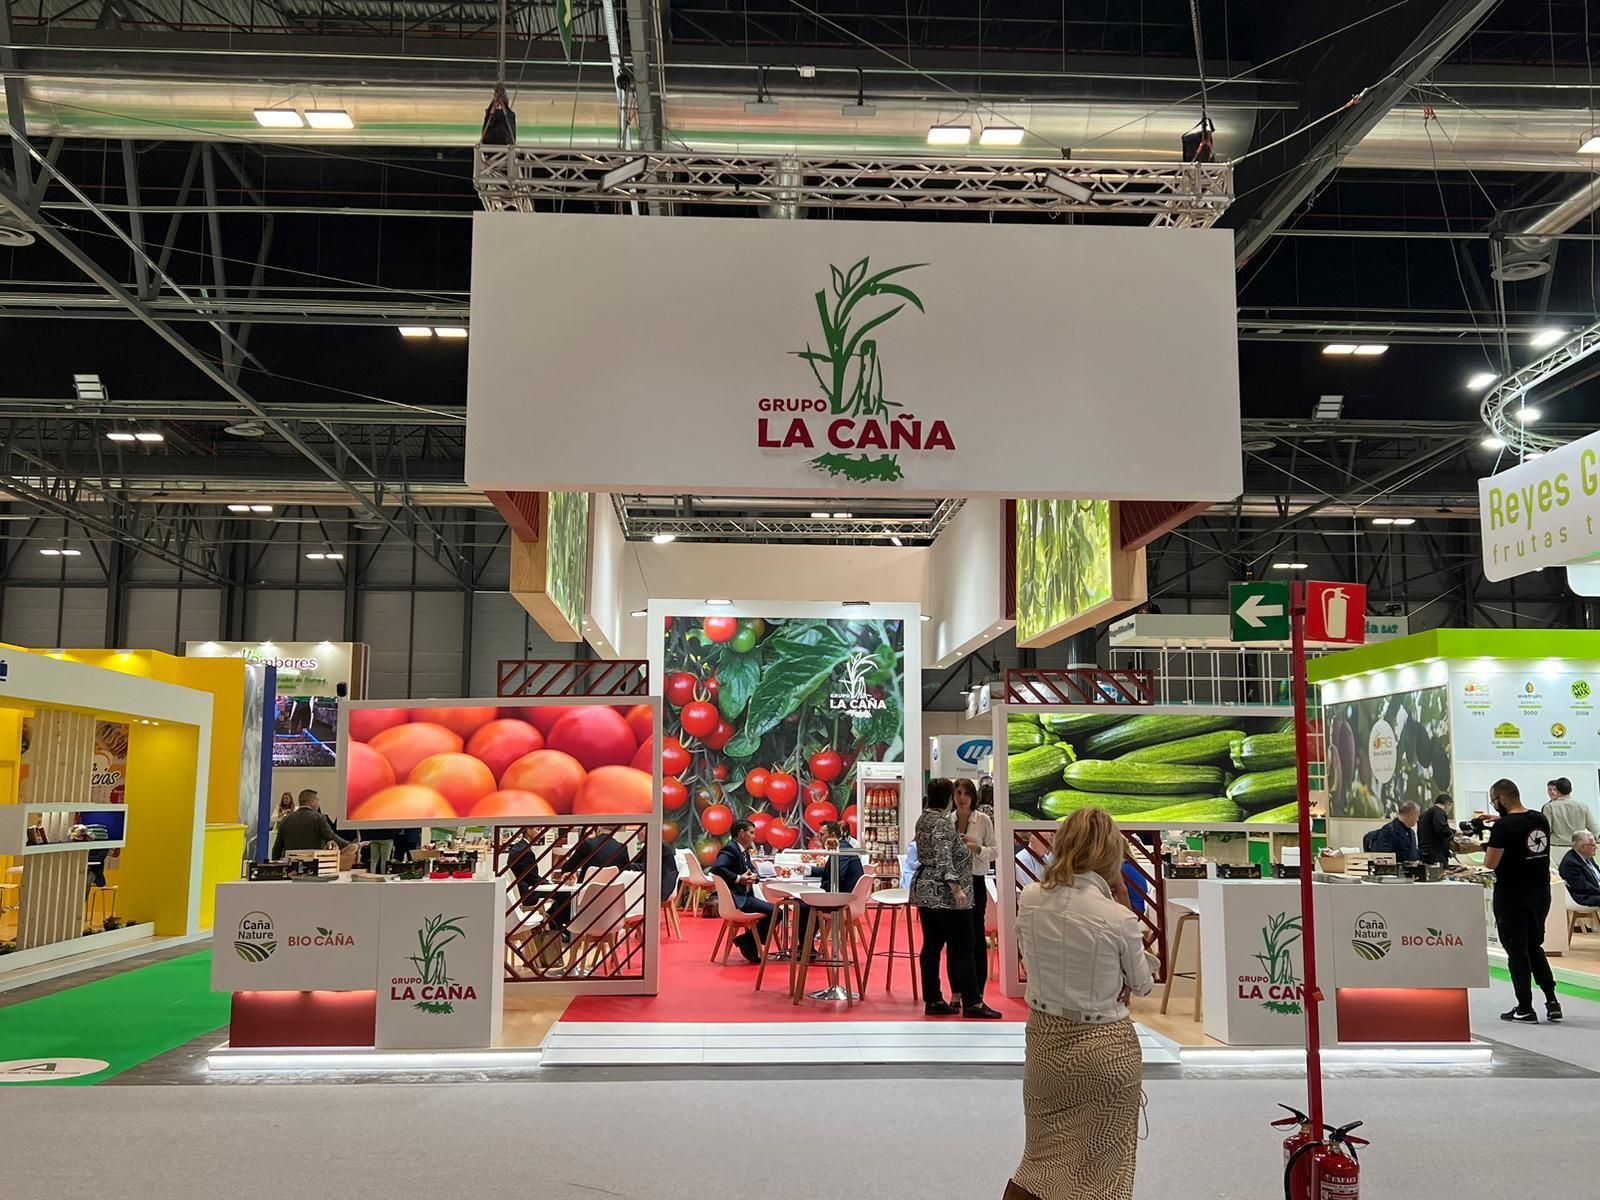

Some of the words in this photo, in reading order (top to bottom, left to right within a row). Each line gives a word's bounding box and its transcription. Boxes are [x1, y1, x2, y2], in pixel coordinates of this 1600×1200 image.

[758, 398, 828, 412] GRUPO
[758, 417, 815, 448] LA
[827, 413, 956, 450] CAÑA
[1489, 473, 1570, 530] Reyes
[1580, 448, 1600, 496] G
[1492, 526, 1568, 565] frutas
[829, 699, 847, 709] LA
[849, 697, 887, 710] CAÑA
[243, 919, 271, 931] Caña
[1358, 919, 1385, 930] Caña
[238, 930, 274, 940] Nature
[288, 936, 312, 946] BIO
[314, 933, 355, 946] CAÑA
[1354, 929, 1388, 939] Nature
[1401, 936, 1424, 946] BIO
[1425, 934, 1464, 946] CAÑA
[391, 977, 422, 985] GRUPO
[1238, 975, 1269, 983] GRUPO
[390, 986, 416, 1000] LA
[421, 983, 477, 1001] CAÑA
[1238, 985, 1264, 1000] LA
